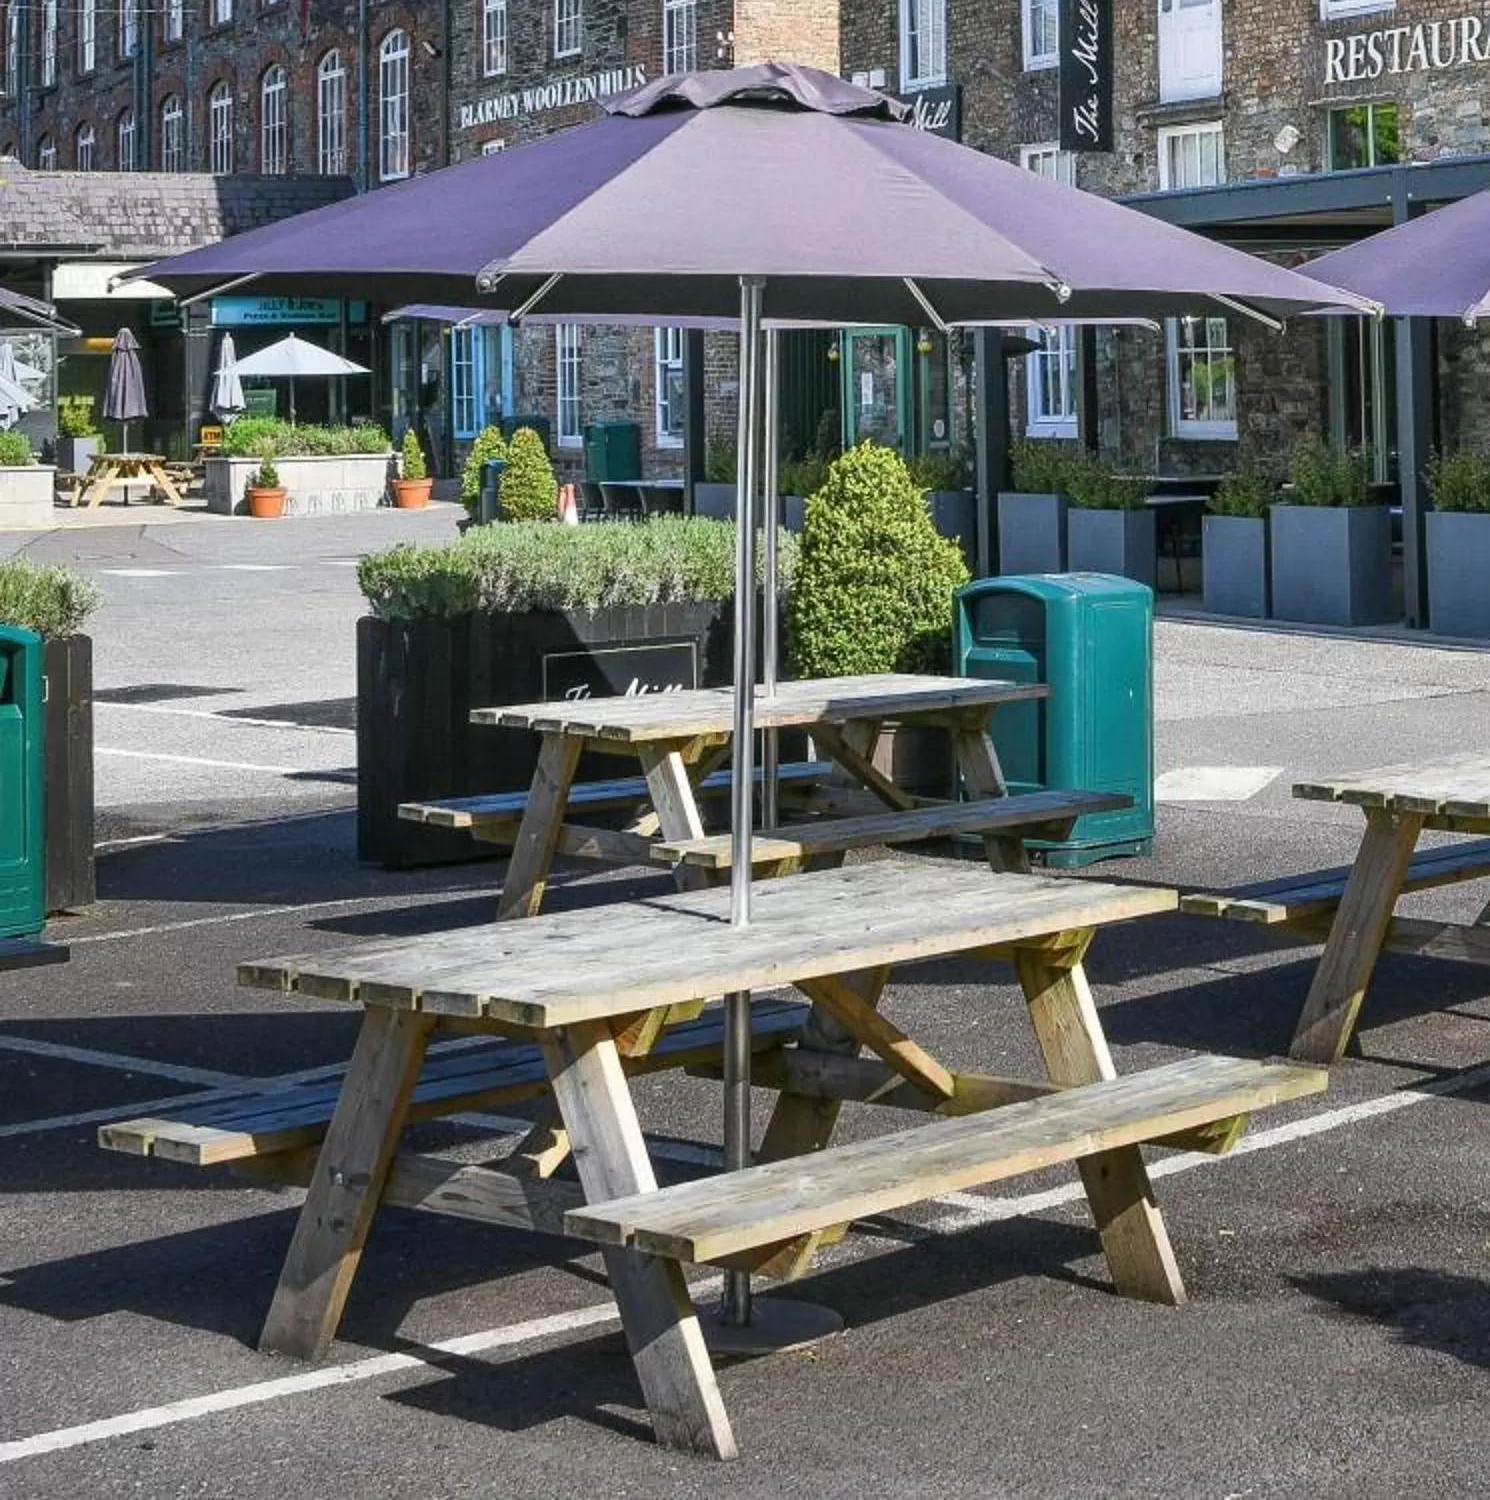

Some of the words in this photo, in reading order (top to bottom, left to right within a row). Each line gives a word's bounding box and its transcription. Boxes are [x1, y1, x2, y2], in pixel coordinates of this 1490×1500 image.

[460, 94, 519, 129] BLARNEY
[523, 74, 597, 113] WOOLLEN
[600, 63, 647, 97] MILLS
[1072, 94, 1099, 143] The
